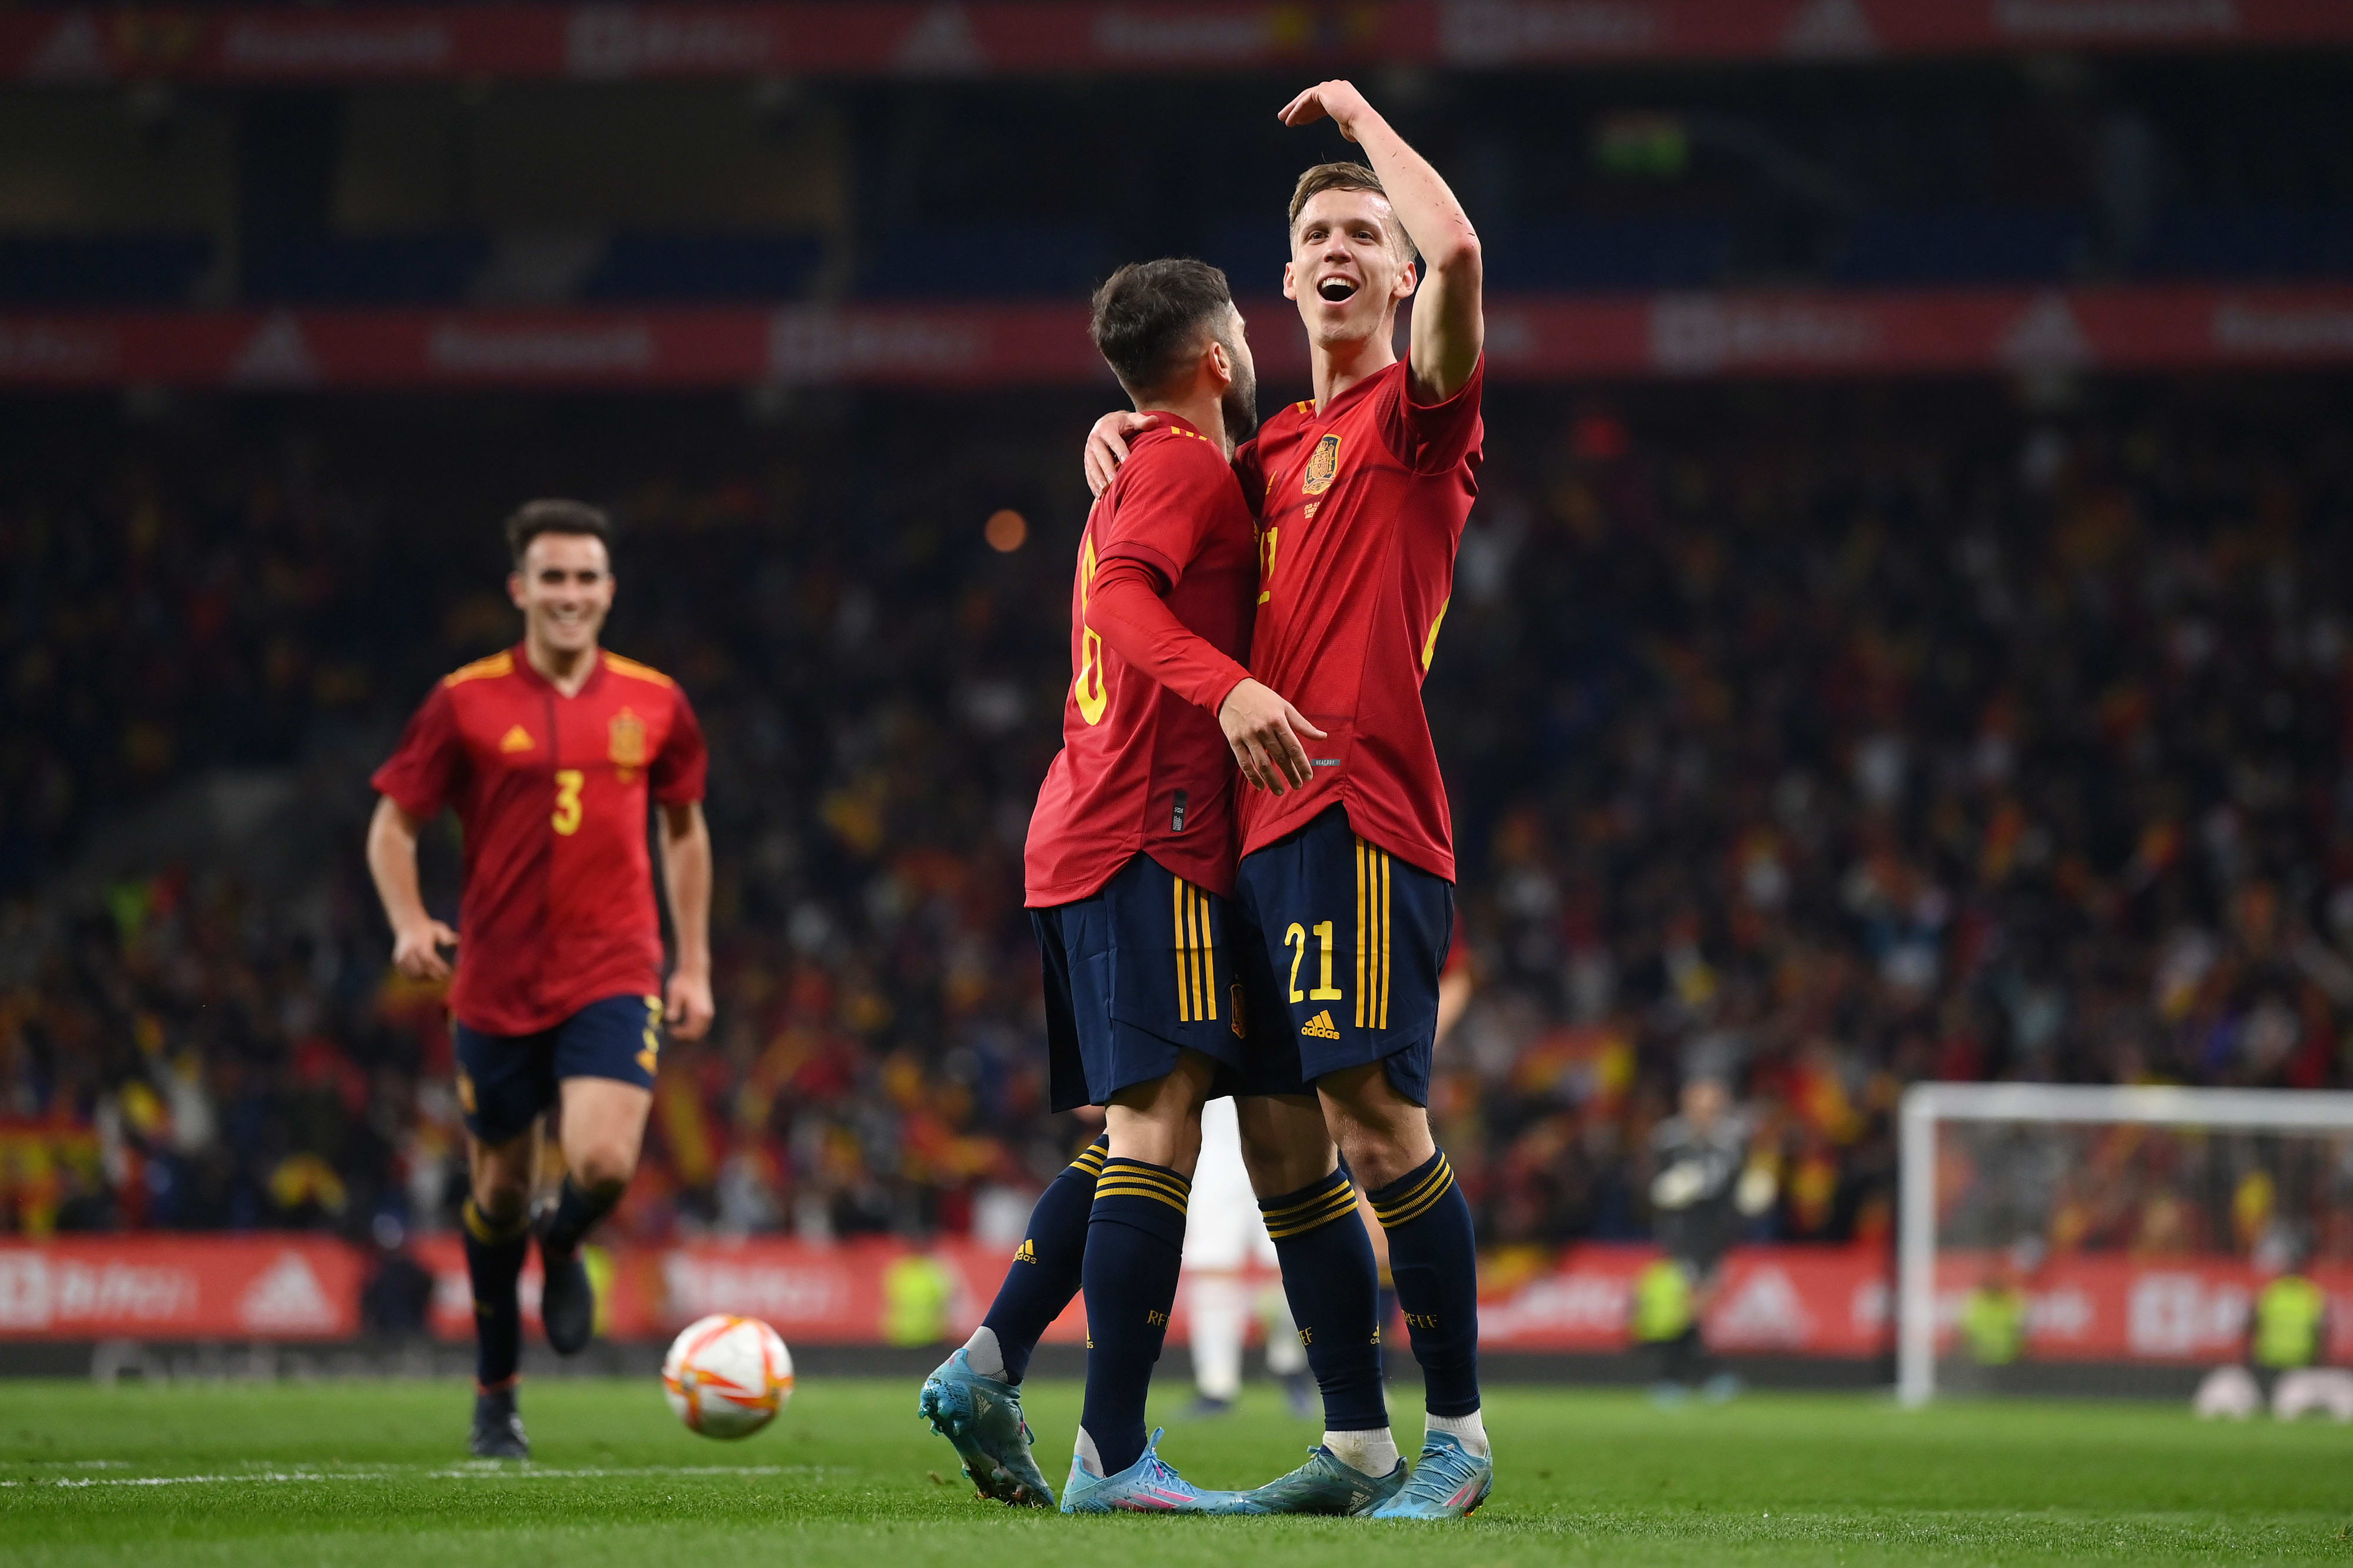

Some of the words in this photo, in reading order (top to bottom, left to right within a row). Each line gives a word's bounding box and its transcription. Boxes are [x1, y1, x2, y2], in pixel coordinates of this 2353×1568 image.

[552, 769, 585, 836] 3
[1285, 920, 1342, 1003] 21
[1301, 1026, 1341, 1040] adidas
